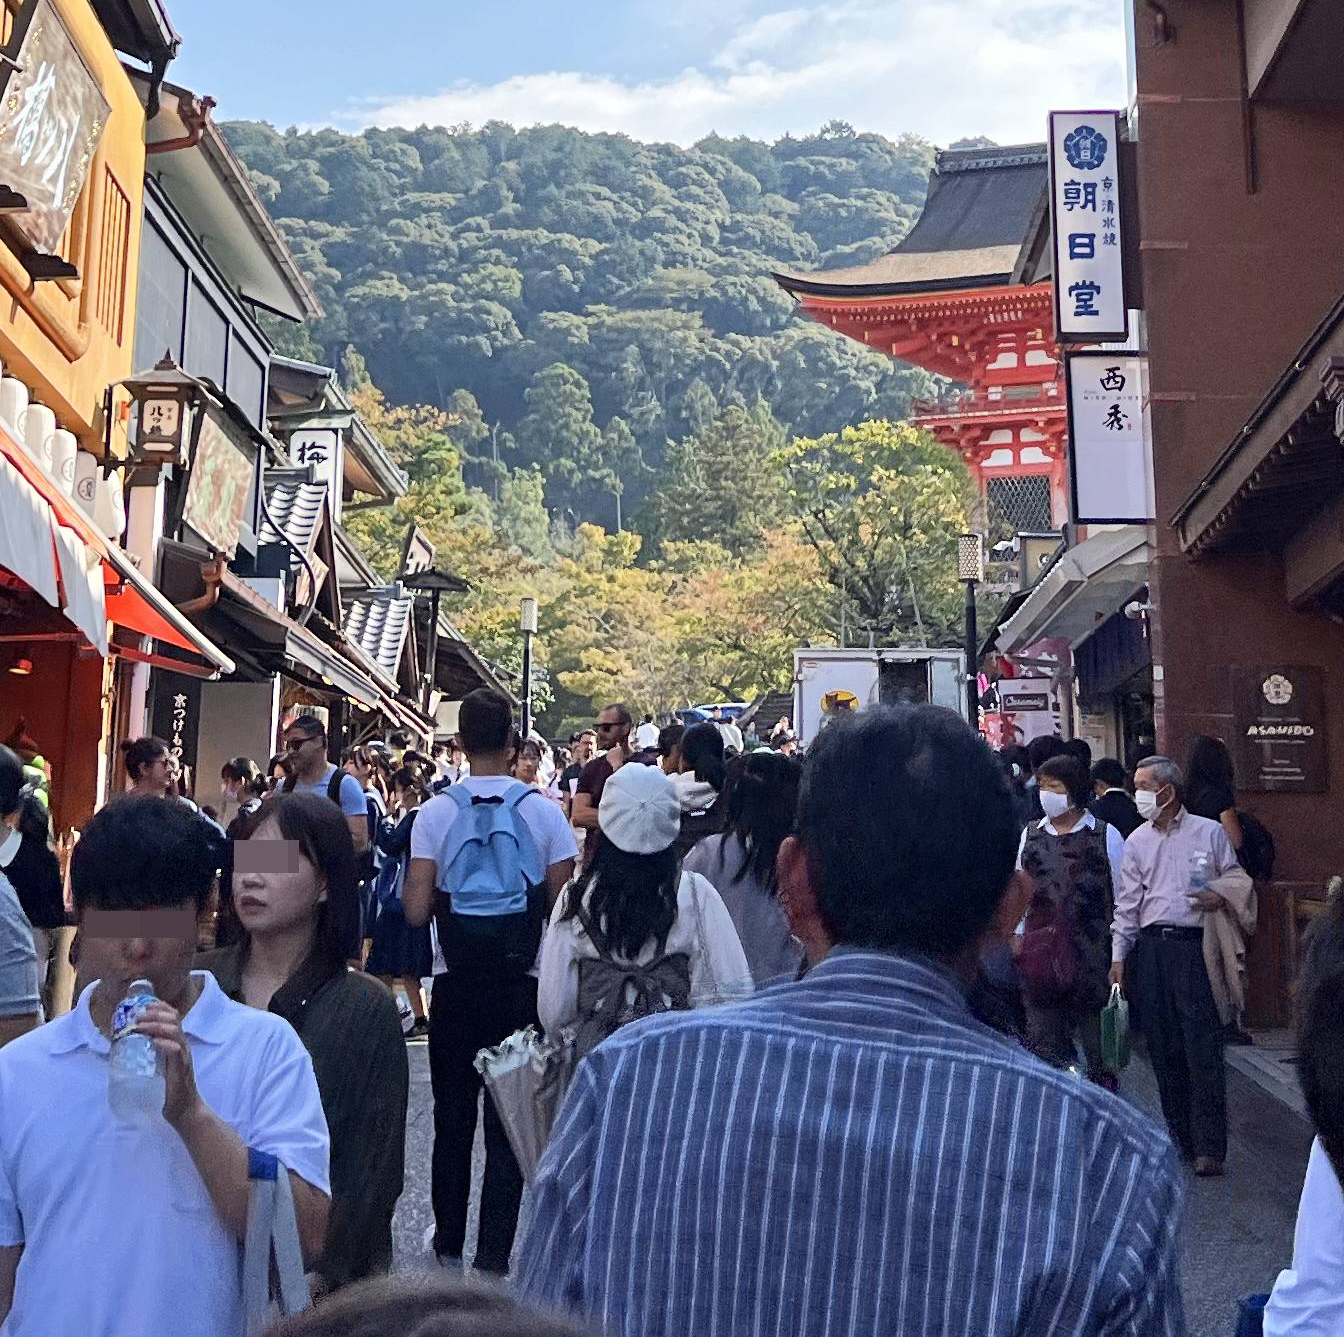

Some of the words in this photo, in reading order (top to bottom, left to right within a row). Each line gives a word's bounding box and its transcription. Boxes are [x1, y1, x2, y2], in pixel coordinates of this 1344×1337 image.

[1063, 179, 1101, 317] 朝日堂
[1100, 366, 1128, 430] 西秀
[1247, 725, 1314, 736] ASAHIDO
